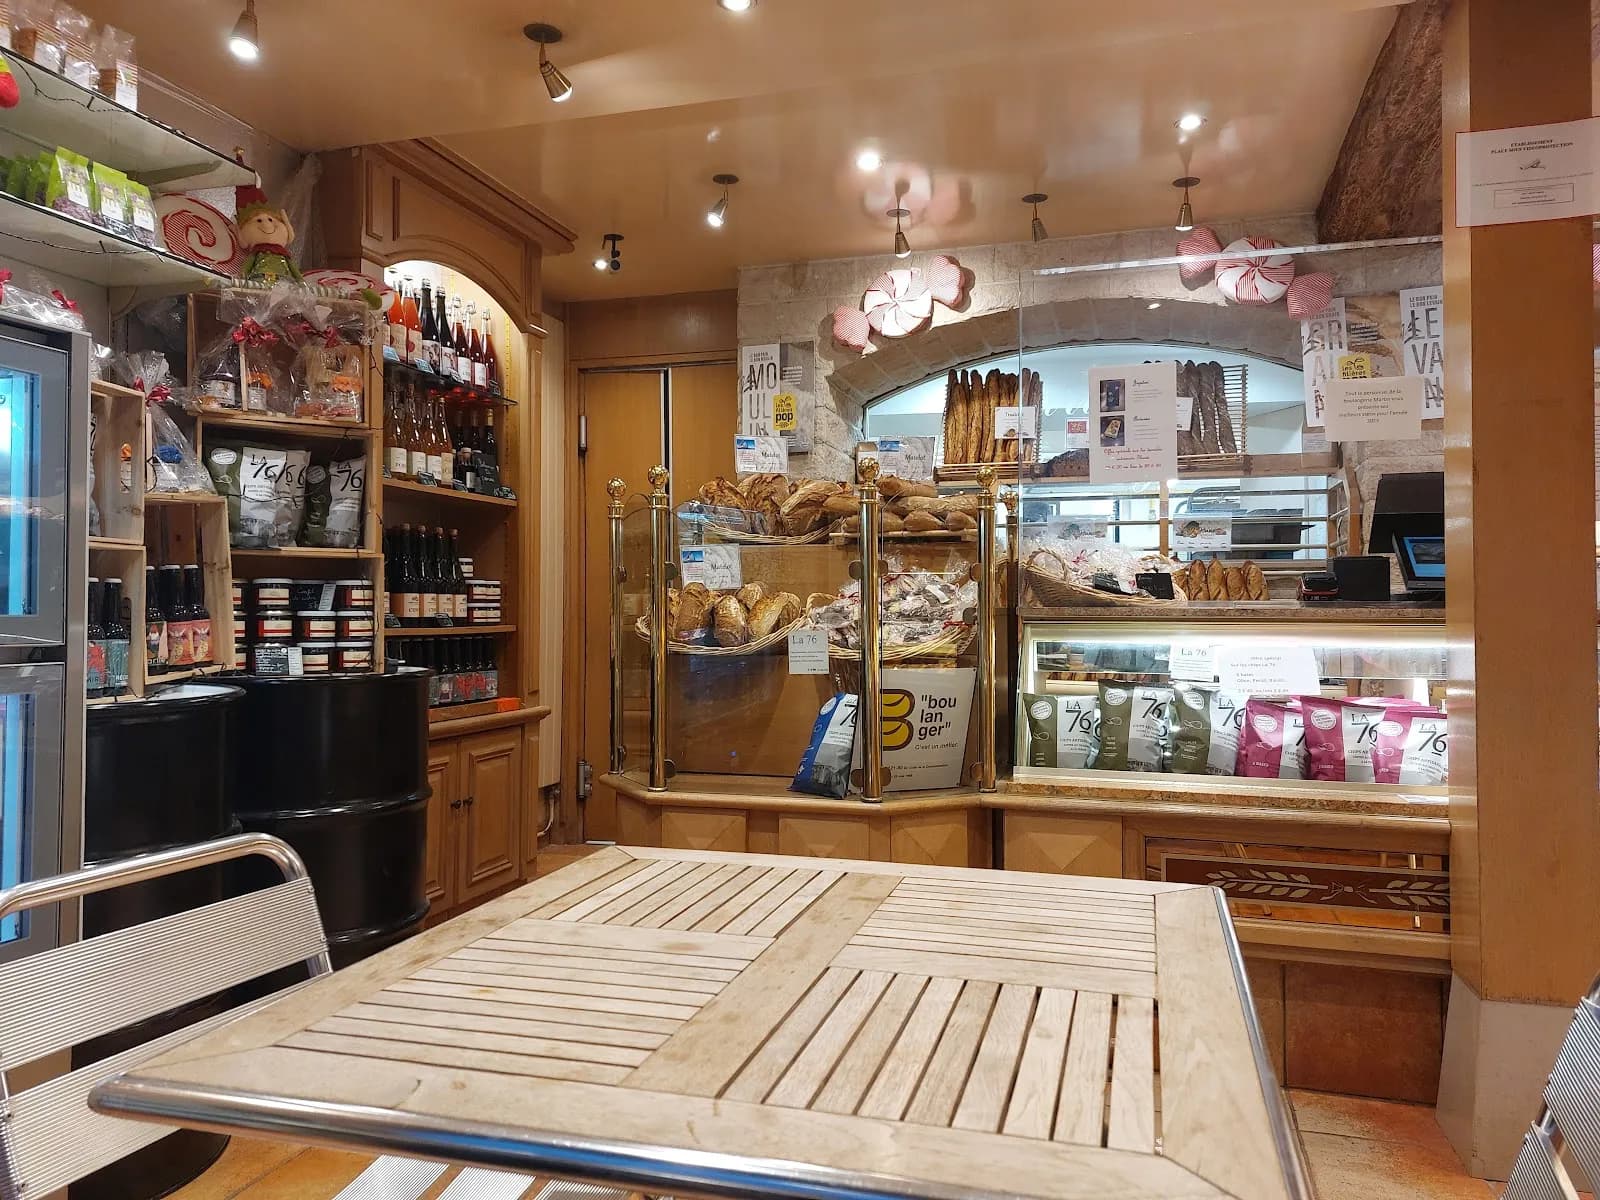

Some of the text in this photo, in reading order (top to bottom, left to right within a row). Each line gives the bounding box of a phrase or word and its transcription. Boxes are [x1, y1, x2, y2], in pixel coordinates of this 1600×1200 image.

[1411, 342, 1443, 375] VA
[749, 362, 777, 391] MO
[749, 393, 771, 420] UL
[775, 412, 794, 424] pop
[251, 454, 267, 464] LA
[336, 461, 352, 470] LA
[336, 469, 363, 492] 76
[792, 634, 817, 645] La 76
[1181, 647, 1207, 657] La 76
[921, 694, 957, 709] "bou
[1142, 690, 1158, 698] LA
[1065, 700, 1081, 710] LA
[1141, 696, 1168, 719] 76
[1218, 697, 1235, 707] LA
[920, 708, 943, 724] lan
[1065, 709, 1092, 734] 76
[1351, 713, 1369, 722] LA
[918, 721, 952, 741] ger"
[1351, 722, 1380, 745] 76
[1420, 723, 1437, 731] LA
[1418, 730, 1448, 756] 76
